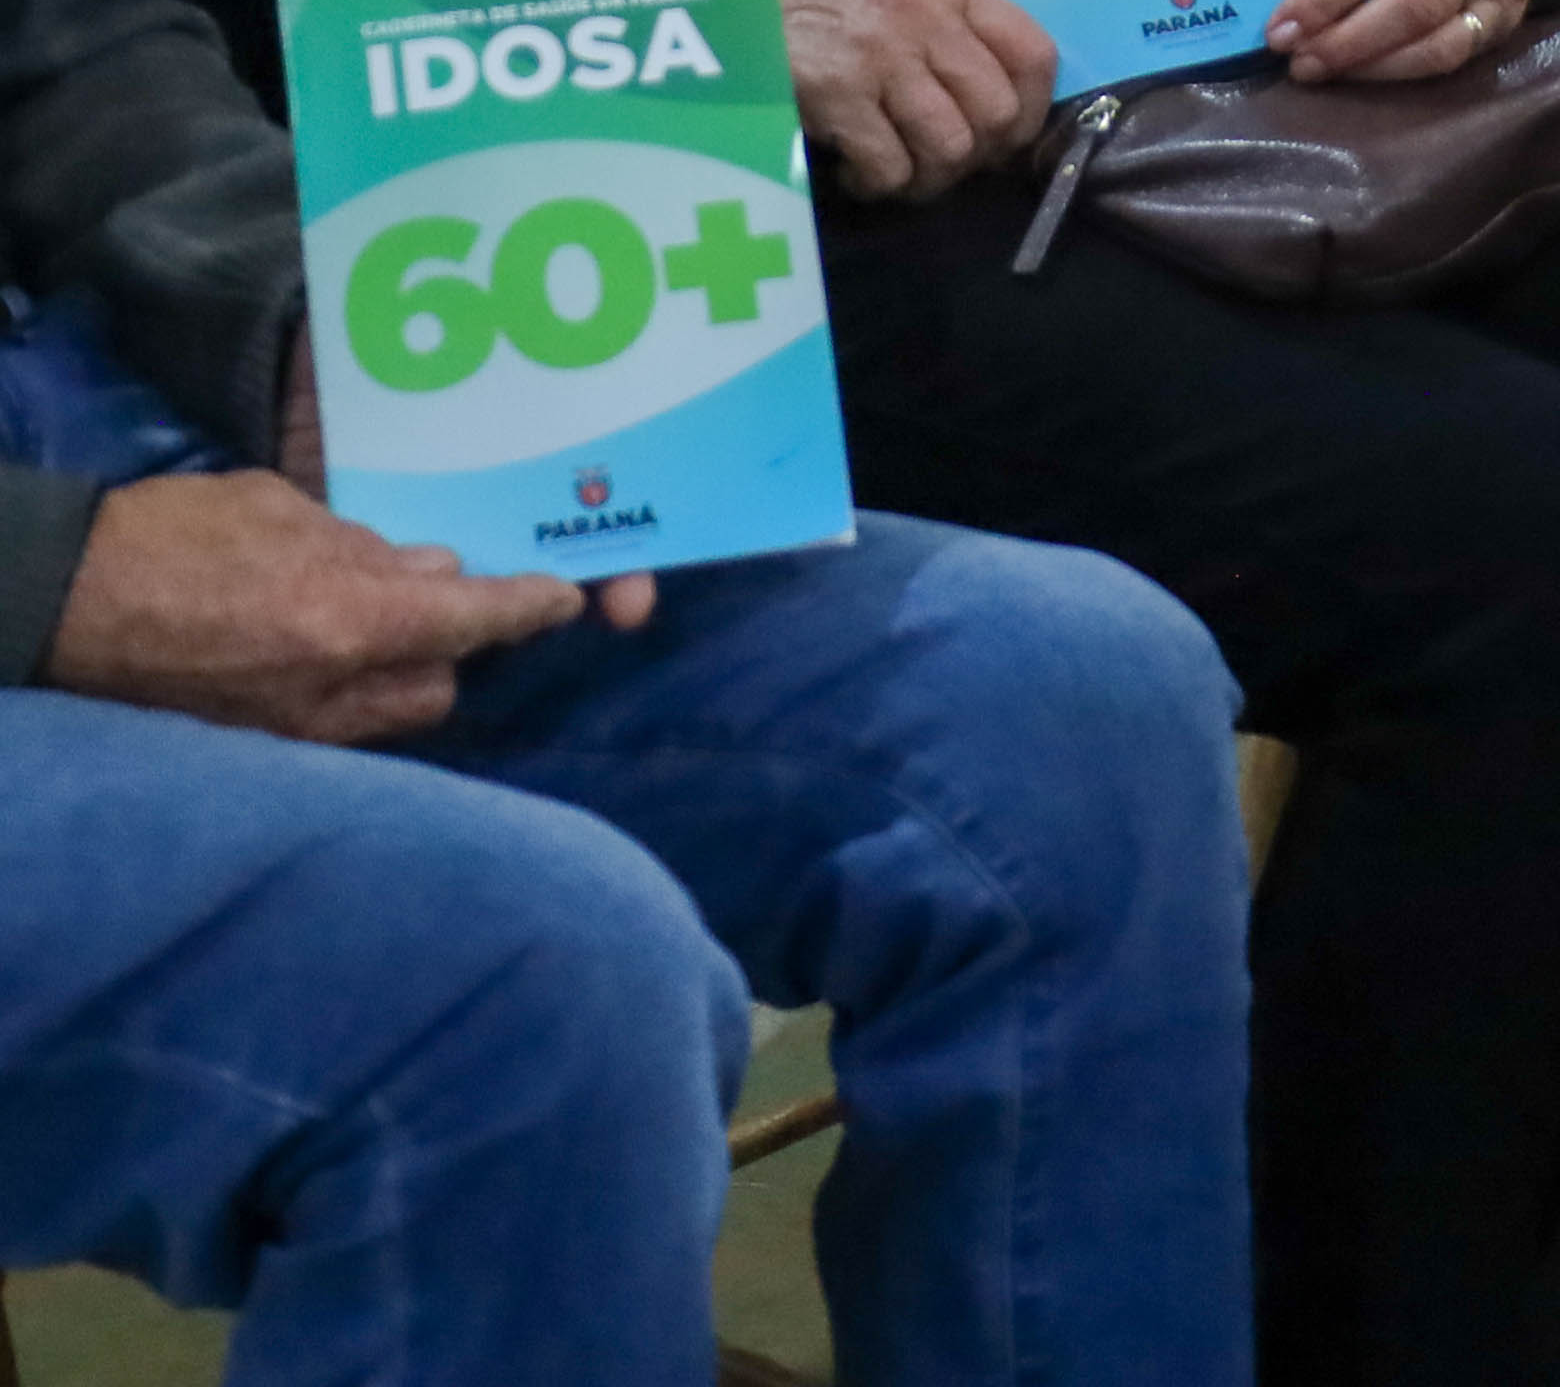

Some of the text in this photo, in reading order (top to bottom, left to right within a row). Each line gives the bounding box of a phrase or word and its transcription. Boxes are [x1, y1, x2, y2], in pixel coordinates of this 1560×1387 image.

[365, 7, 723, 118] IDOSA
[488, 3, 522, 22] DE
[345, 197, 792, 393] 60+
